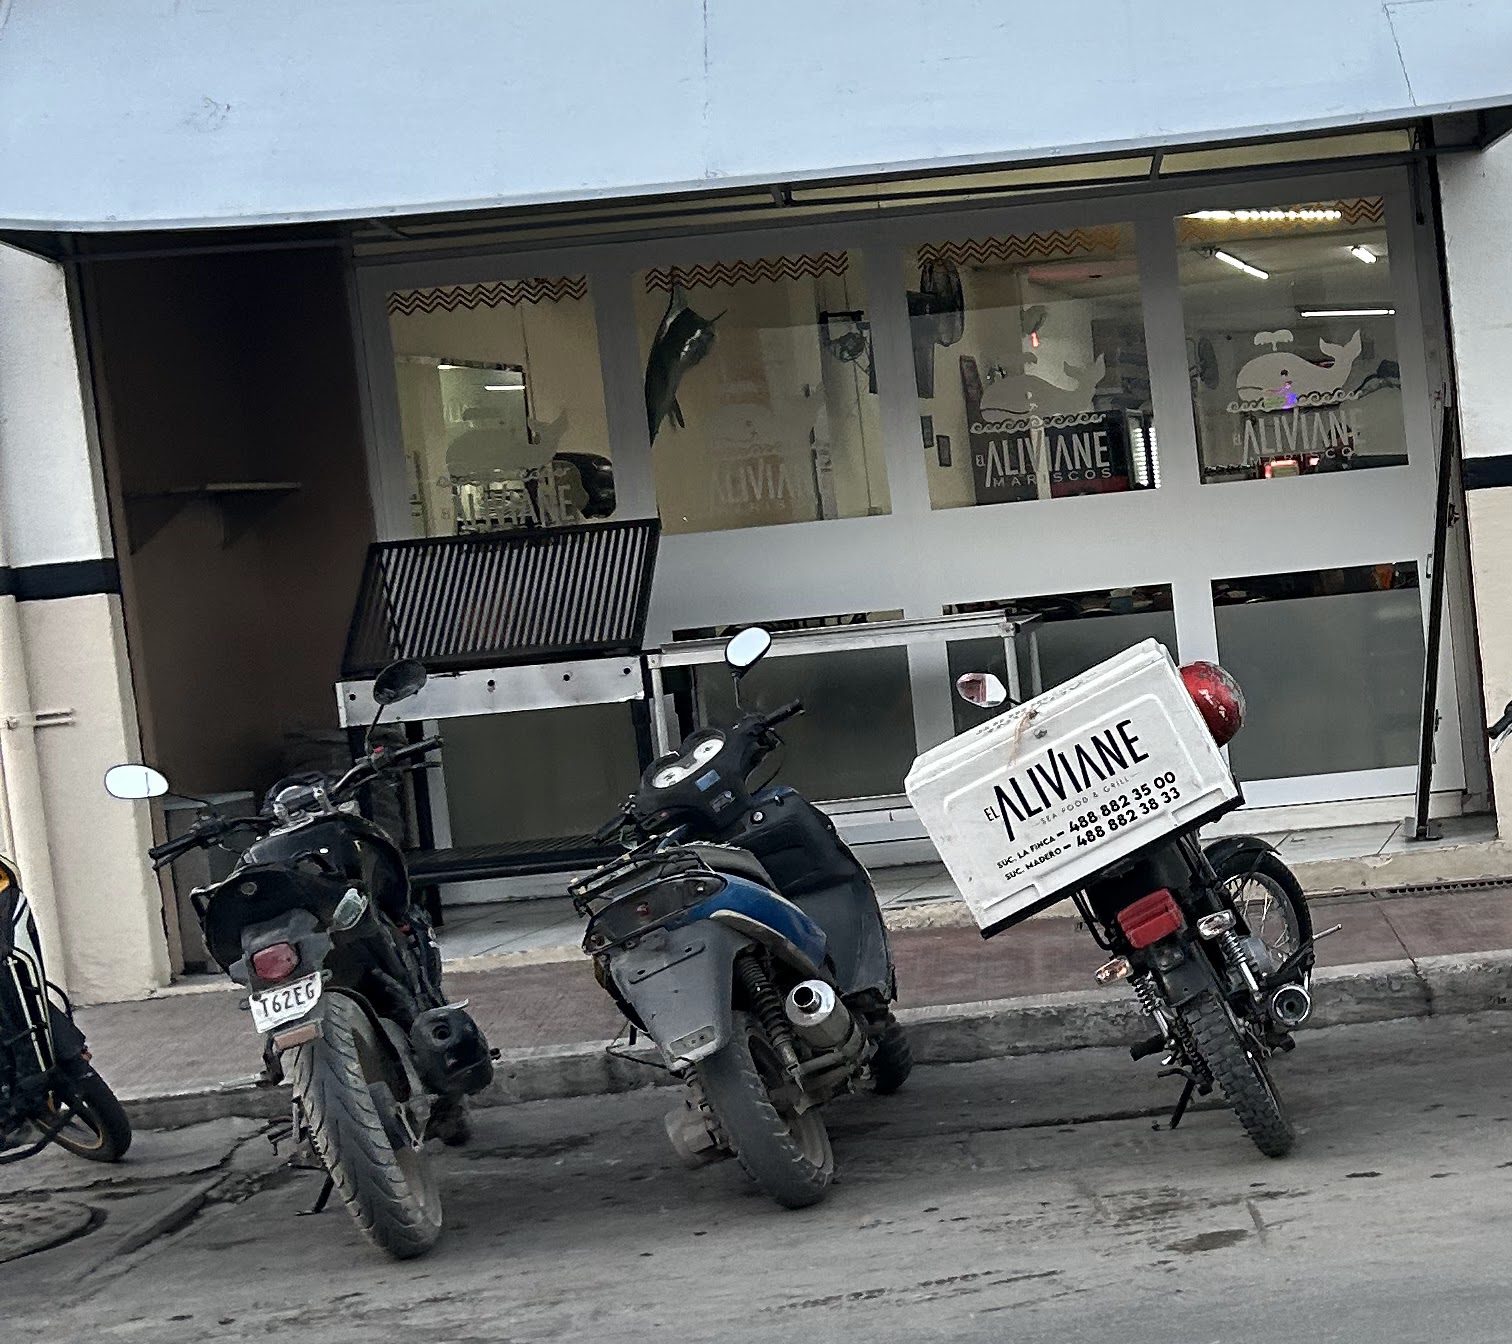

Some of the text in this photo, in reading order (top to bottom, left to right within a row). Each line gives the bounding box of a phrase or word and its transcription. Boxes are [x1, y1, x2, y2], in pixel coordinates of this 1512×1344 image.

[983, 719, 1150, 842] EL ALIVIANE
[996, 855, 1017, 869] SUC.
[1017, 849, 1030, 859] LA
[1030, 835, 1056, 852] FINCA
[1069, 810, 1098, 833] 488
[1100, 794, 1131, 817] 882
[1131, 783, 1152, 801] 35
[1153, 771, 1176, 789] 00
[1004, 867, 1025, 881] SUC.
[1025, 847, 1062, 870] MADERO
[1077, 825, 1105, 848] 488
[1107, 809, 1138, 831] 882
[1139, 797, 1159, 815] 38
[1161, 786, 1181, 804] 33
[260, 982, 315, 1017] T62EG
